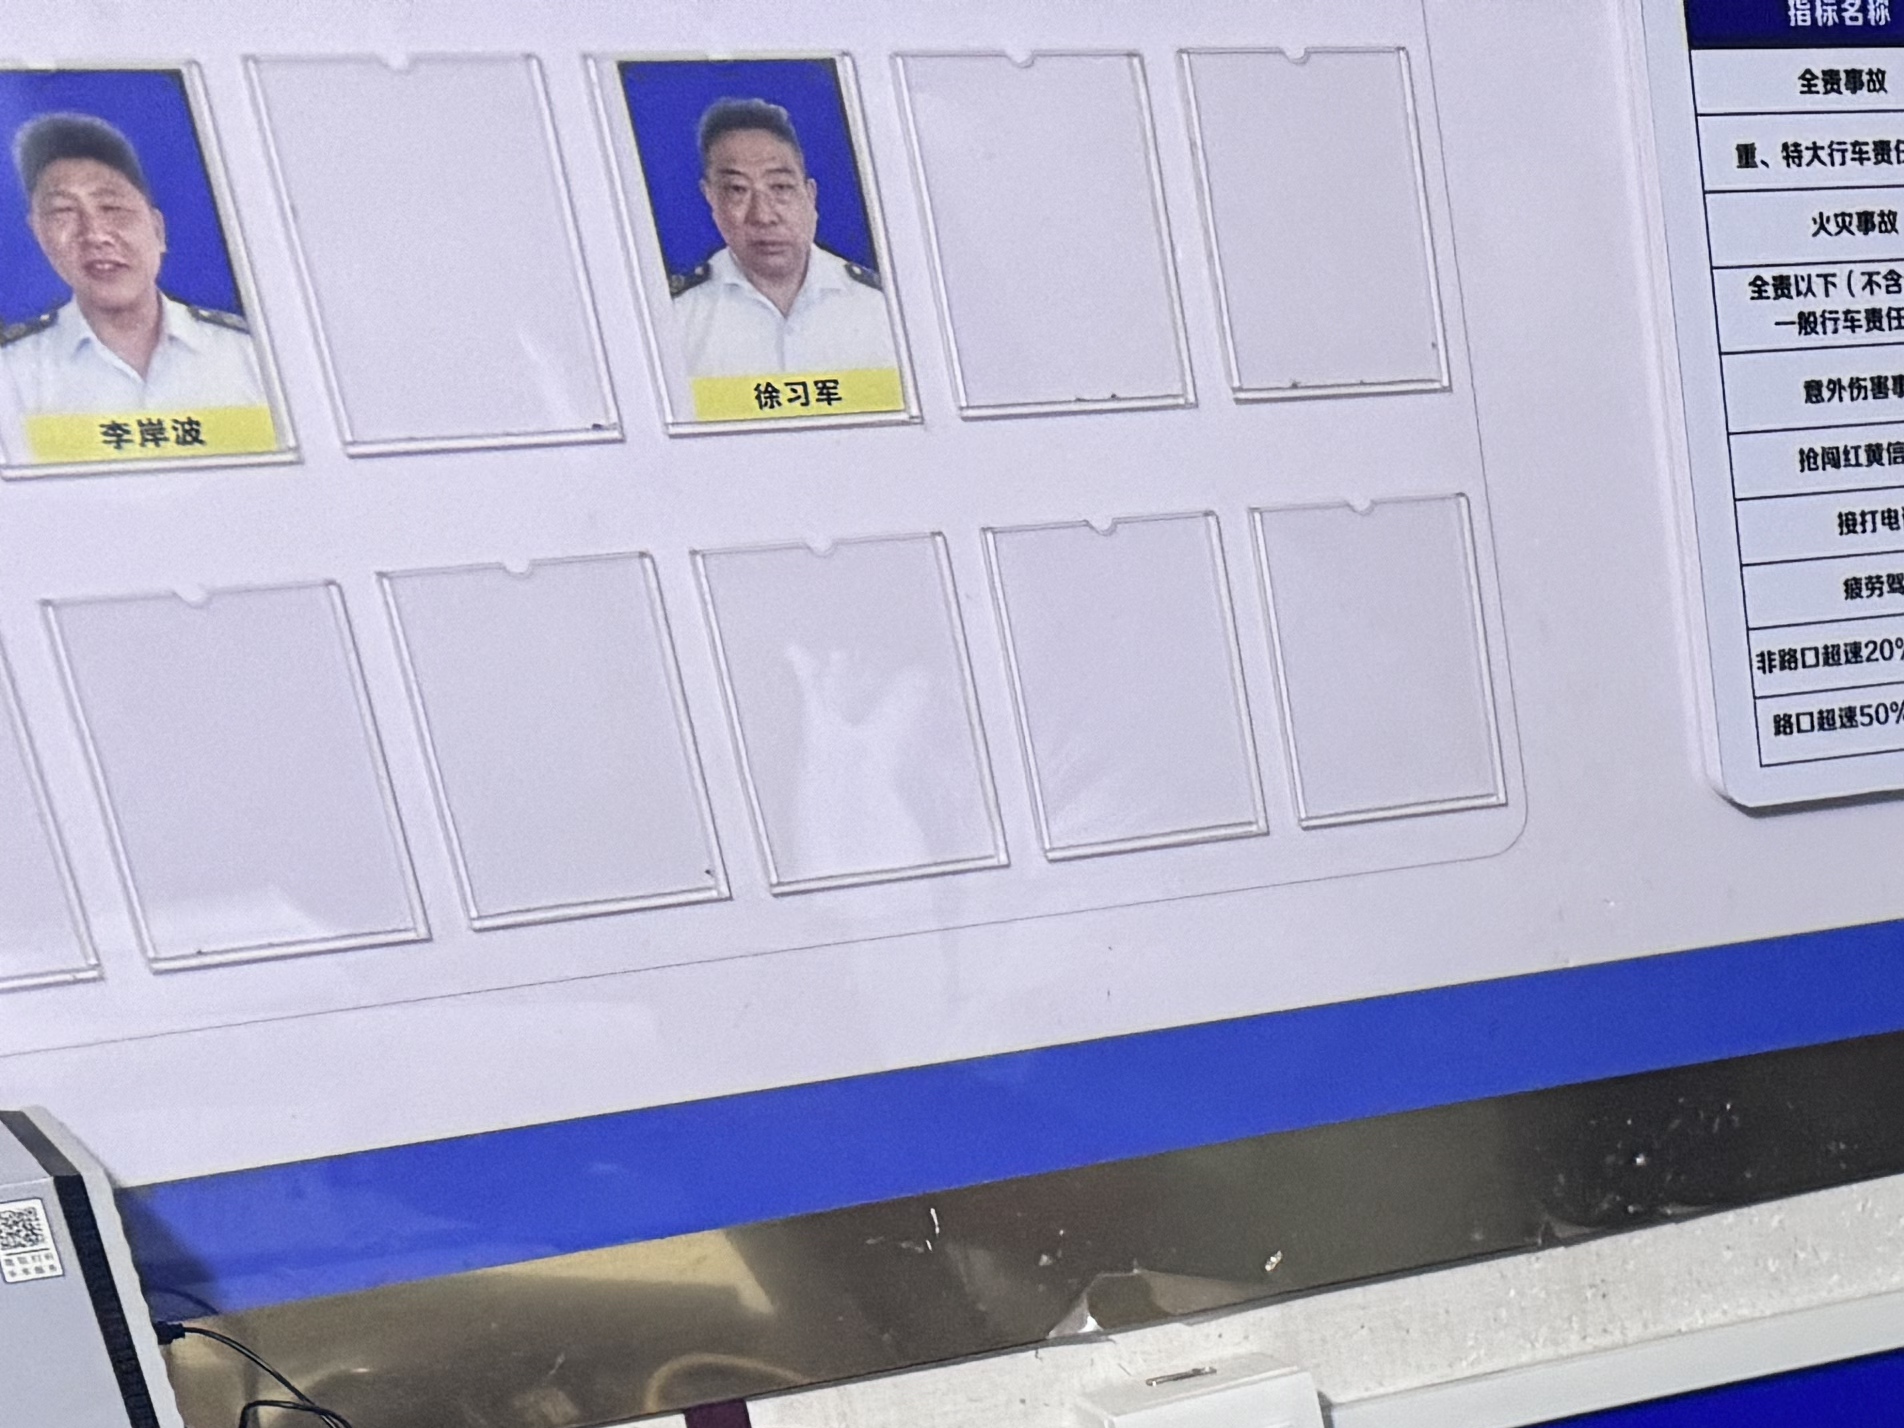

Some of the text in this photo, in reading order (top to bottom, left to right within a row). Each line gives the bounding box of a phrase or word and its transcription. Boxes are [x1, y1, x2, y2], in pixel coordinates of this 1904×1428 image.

[1798, 67, 1889, 96] 全责事故
[1811, 209, 1900, 238] 火灾事故
[753, 378, 843, 410] 徐习军
[99, 417, 206, 450] 李岸波
